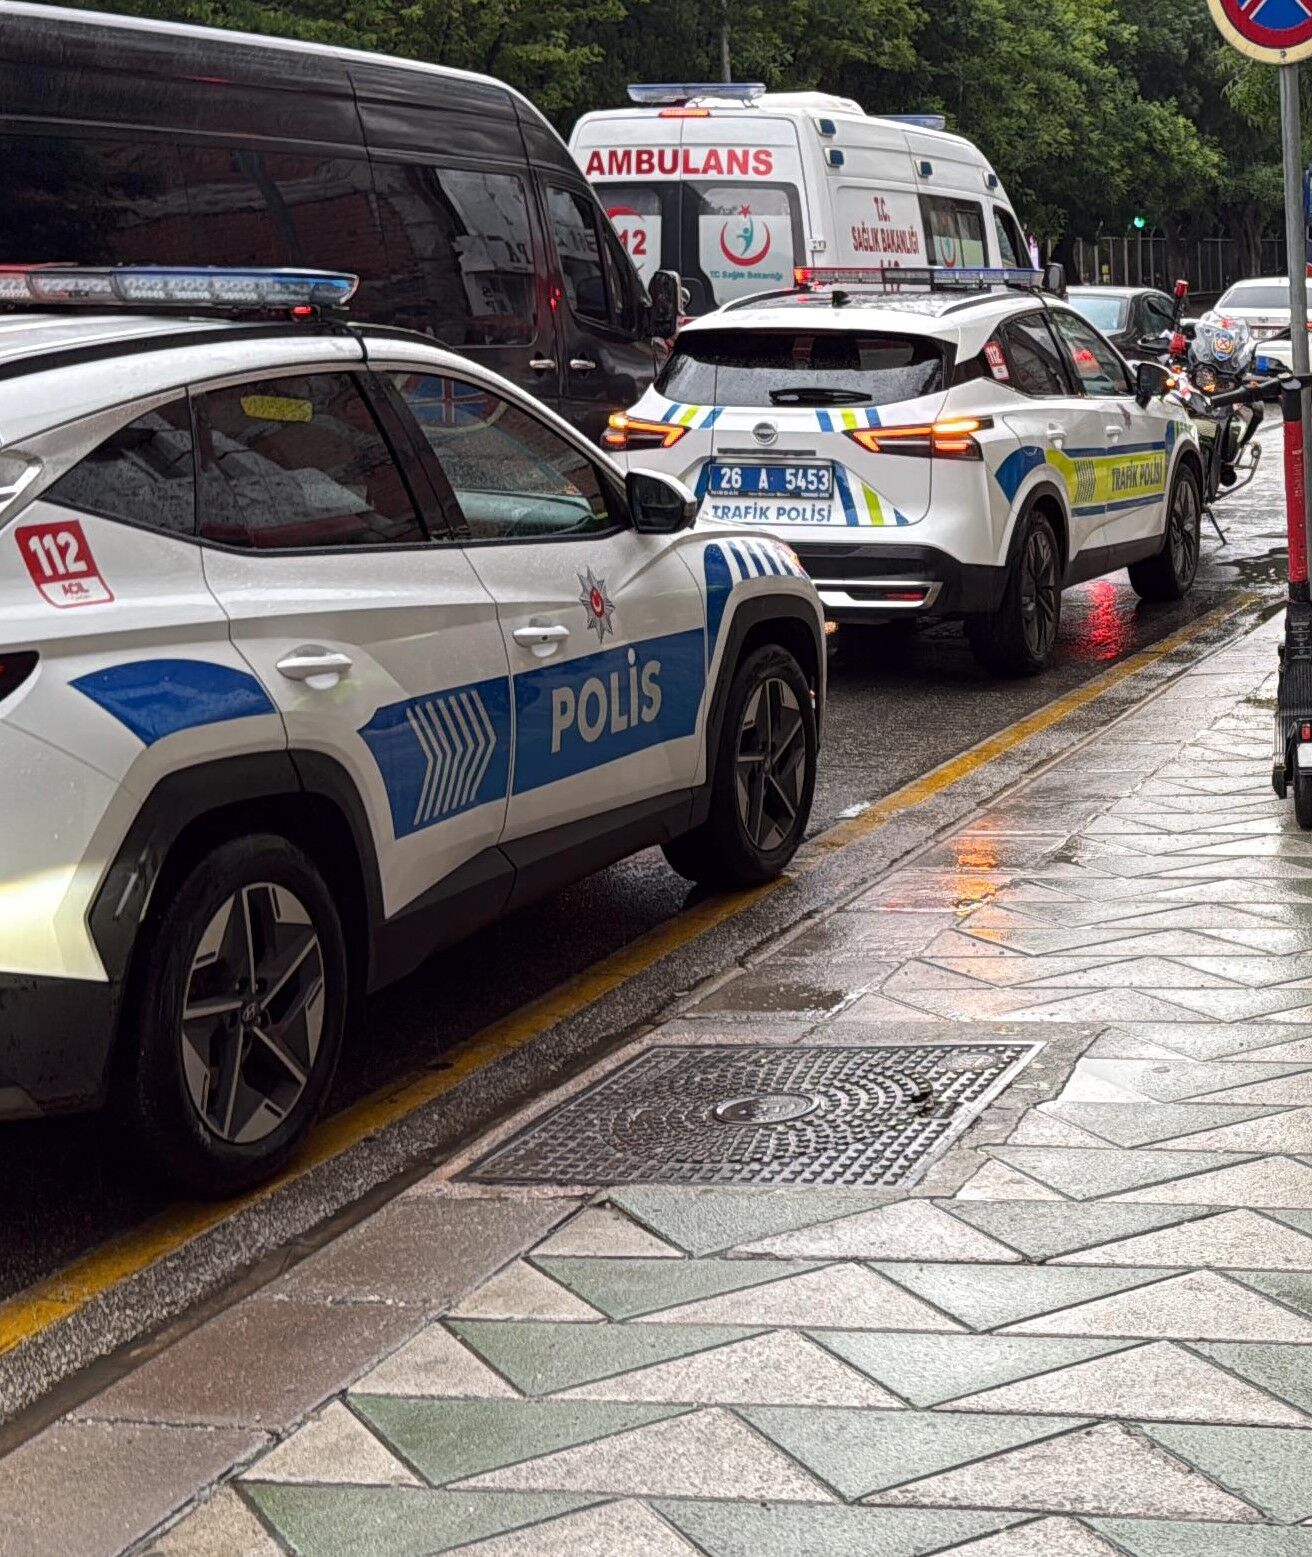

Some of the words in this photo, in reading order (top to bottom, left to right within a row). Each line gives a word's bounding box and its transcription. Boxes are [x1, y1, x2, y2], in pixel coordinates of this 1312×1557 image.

[585, 148, 774, 176] AMBULANS
[851, 221, 881, 252] SAĞLIK
[720, 467, 742, 489] 26
[758, 468, 770, 491] A
[785, 468, 830, 491] 5453
[1111, 459, 1139, 493] TRAFİK
[712, 501, 771, 521] TRAFİK
[776, 503, 833, 523] POLİSİ
[28, 531, 89, 577] 112
[551, 647, 663, 754] POLİS
